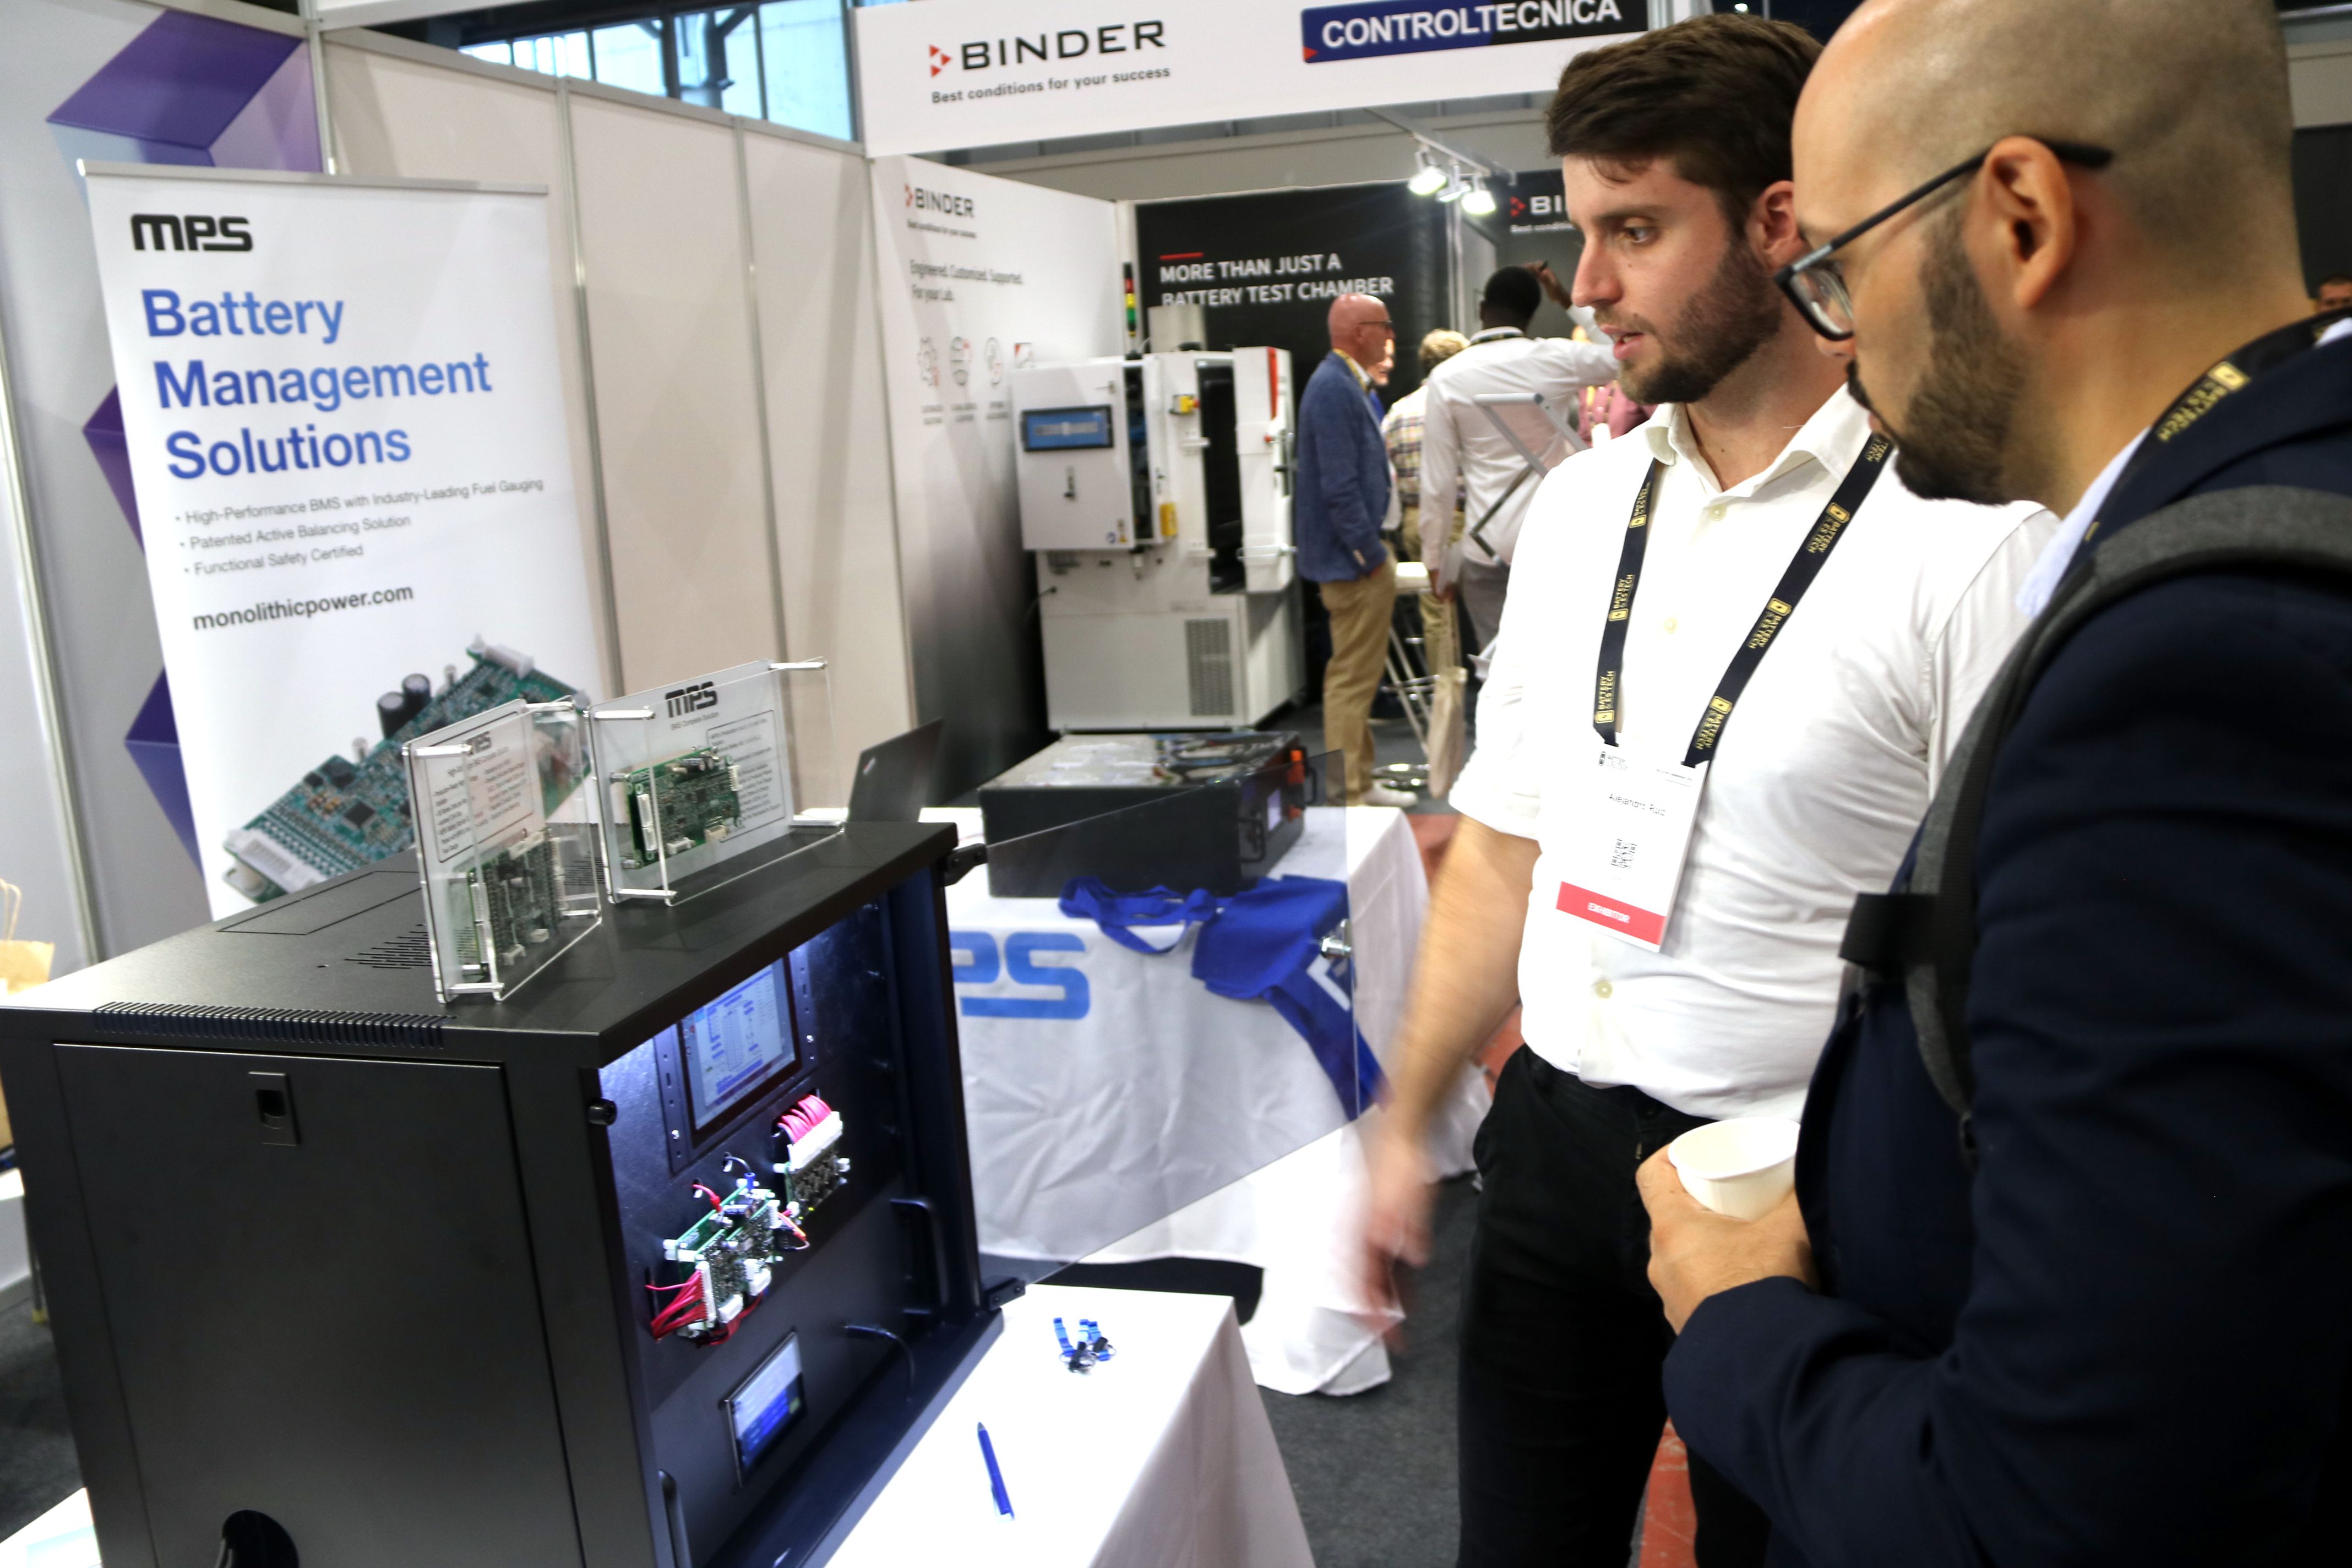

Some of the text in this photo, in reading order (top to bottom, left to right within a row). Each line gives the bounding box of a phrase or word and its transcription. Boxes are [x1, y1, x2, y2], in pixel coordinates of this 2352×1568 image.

[1322, 0, 1621, 47] CONTROLTECNICA
[961, 19, 1166, 70] BINDER
[932, 67, 1170, 103] Best conditions for your success
[915, 187, 974, 217] BINDER
[130, 214, 253, 252] MPS
[1159, 253, 1342, 284] MORE THAN JUST A
[1162, 276, 1393, 307] BATTERY TEST CHAMBER
[141, 288, 344, 344] Battery
[154, 353, 492, 412] Management
[166, 425, 411, 480] Solutions
[186, 479, 543, 525] High-Performance BMS with Industry-Leading Fuel Gauging
[190, 516, 410, 549] Patented Active Balancing Solution
[1807, 533, 1826, 553] TECH
[1817, 521, 1842, 553] BATTERY
[194, 544, 363, 575] Functional Safety Certified
[1613, 579, 1625, 609] BATTERY
[1625, 574, 1634, 592] TECH
[193, 586, 413, 630] monolithicpower.com
[1748, 629, 1766, 649] TECH
[1758, 615, 1783, 647] BATTERY
[665, 681, 718, 718] MPS
[1598, 676, 1607, 709] BATTERY
[1703, 713, 1724, 748] BATTERY
